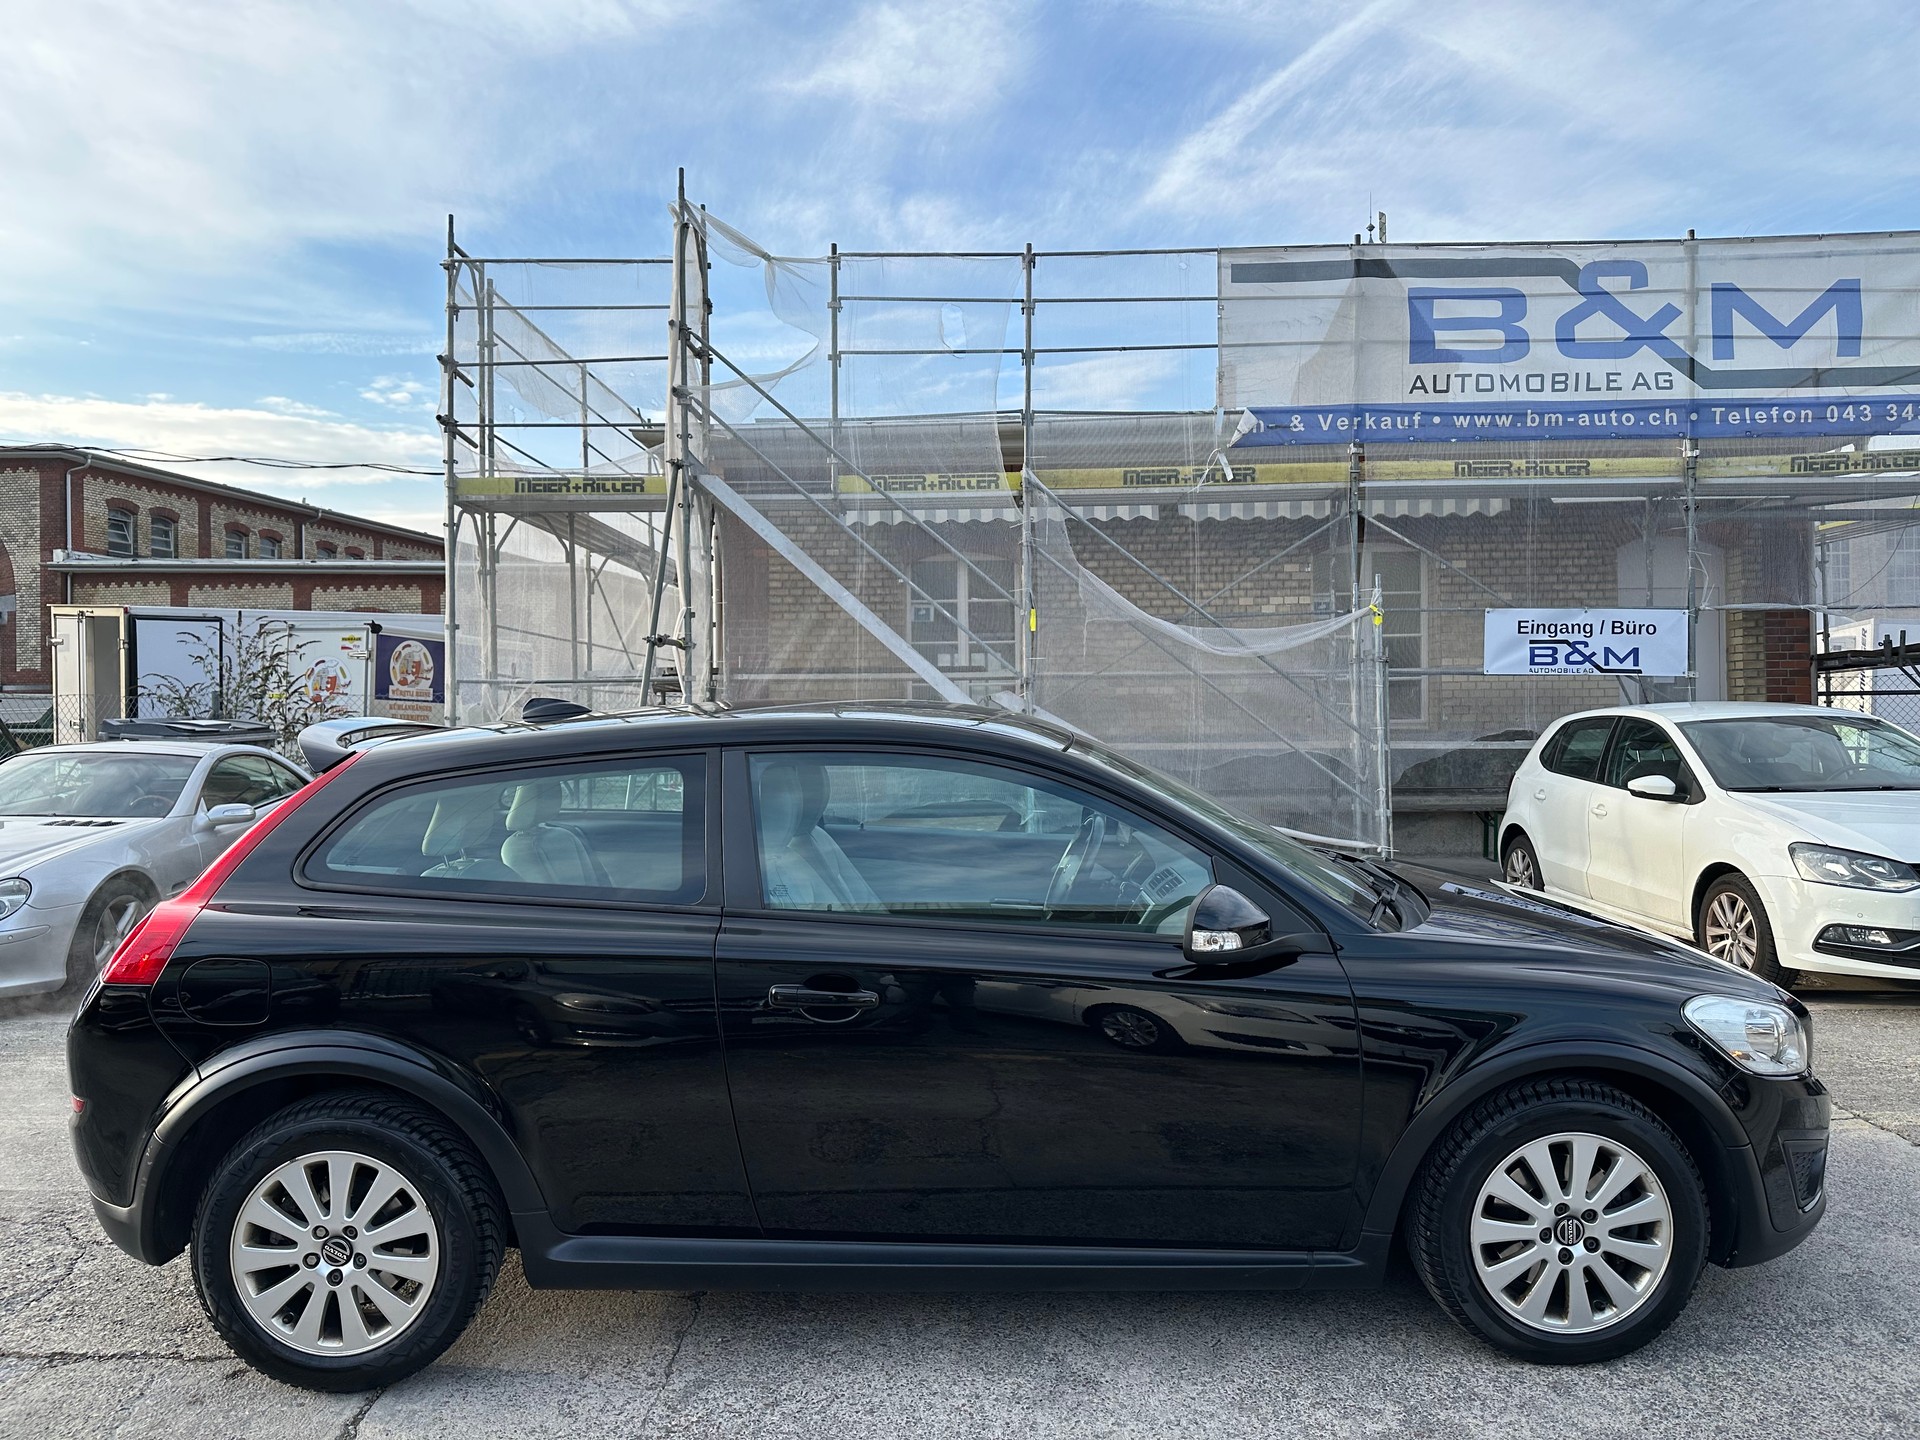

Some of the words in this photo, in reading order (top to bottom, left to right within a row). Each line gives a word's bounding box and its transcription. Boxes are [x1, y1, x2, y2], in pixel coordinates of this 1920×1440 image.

[1407, 259, 1864, 364] B&M
[1408, 371, 1623, 394] AUTOMOBILE
[1631, 371, 1674, 392] AG
[1289, 414, 1305, 432] &
[1317, 411, 1422, 431] Verkauf
[1452, 407, 1678, 428] www.bm-auto.ch
[1711, 406, 1814, 425] Telefon
[1826, 403, 1873, 423] 043
[1885, 402, 1920, 422] 34
[1517, 620, 1594, 638] Eingang
[1599, 620, 1606, 635] /
[1611, 620, 1658, 636] Büro
[1529, 640, 1640, 667] B&M
[324, 1245, 348, 1261] VOLVO
